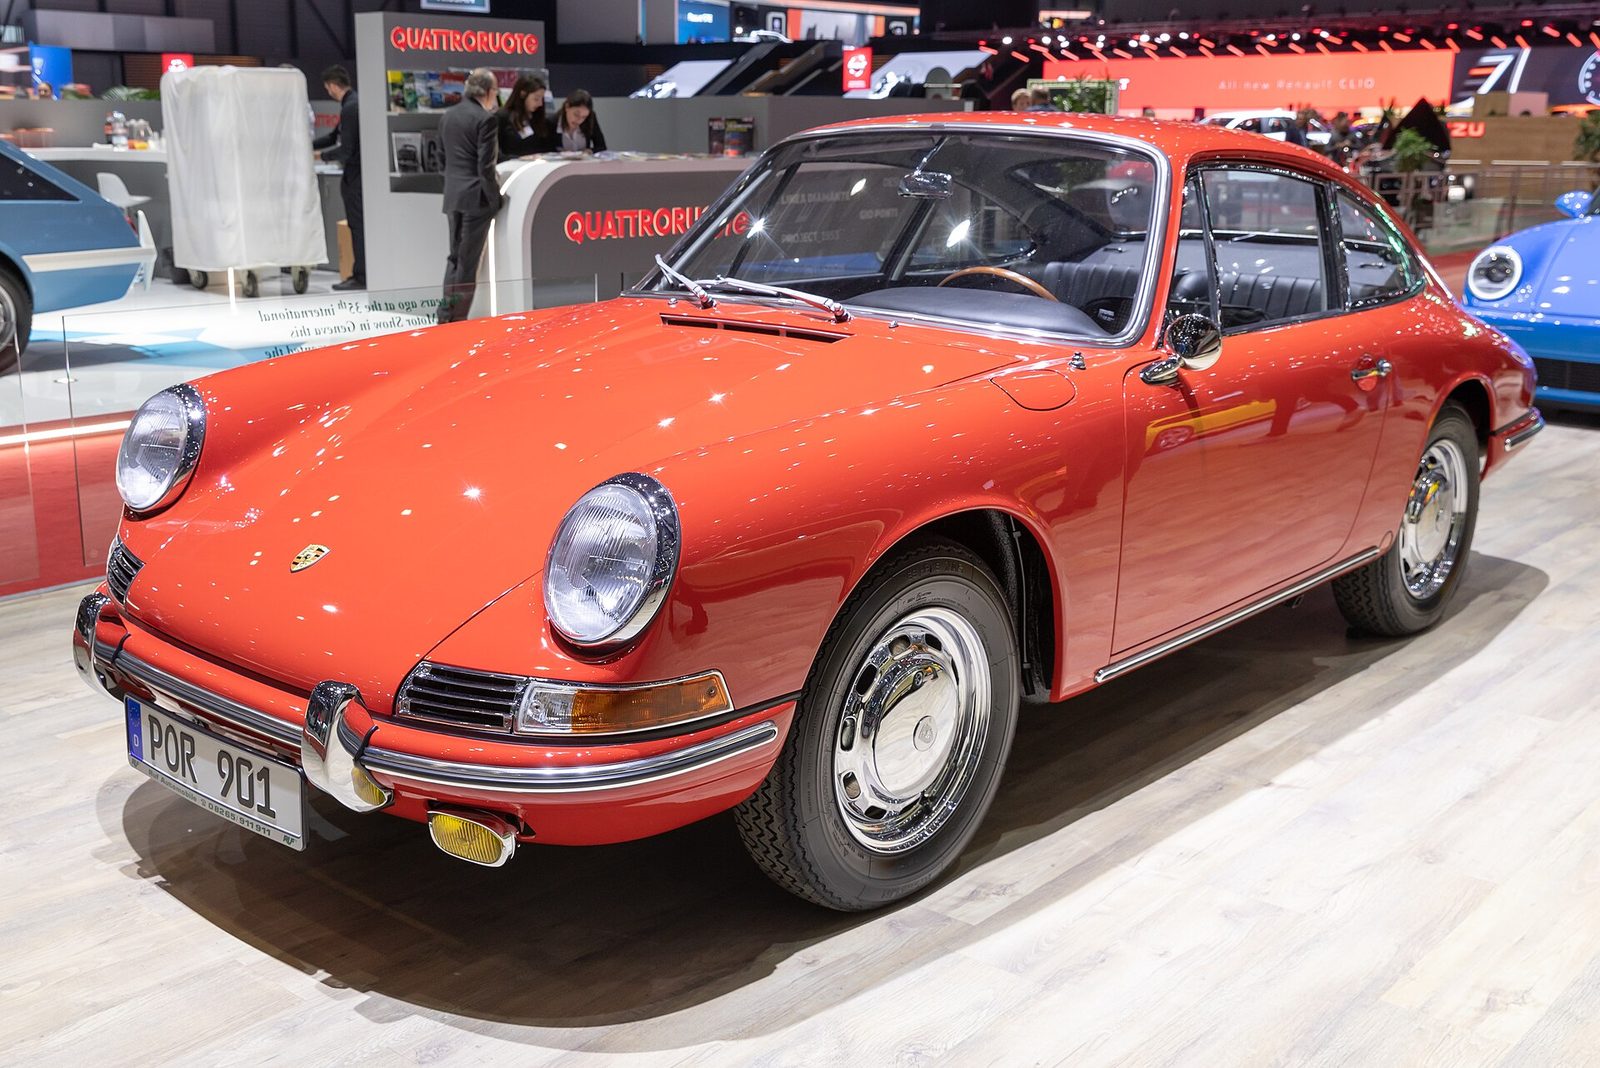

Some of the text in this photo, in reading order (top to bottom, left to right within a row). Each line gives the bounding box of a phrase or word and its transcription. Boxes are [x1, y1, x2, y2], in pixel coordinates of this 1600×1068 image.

[1338, 77, 1375, 89] CLIO
[148, 714, 276, 819] POR 901
